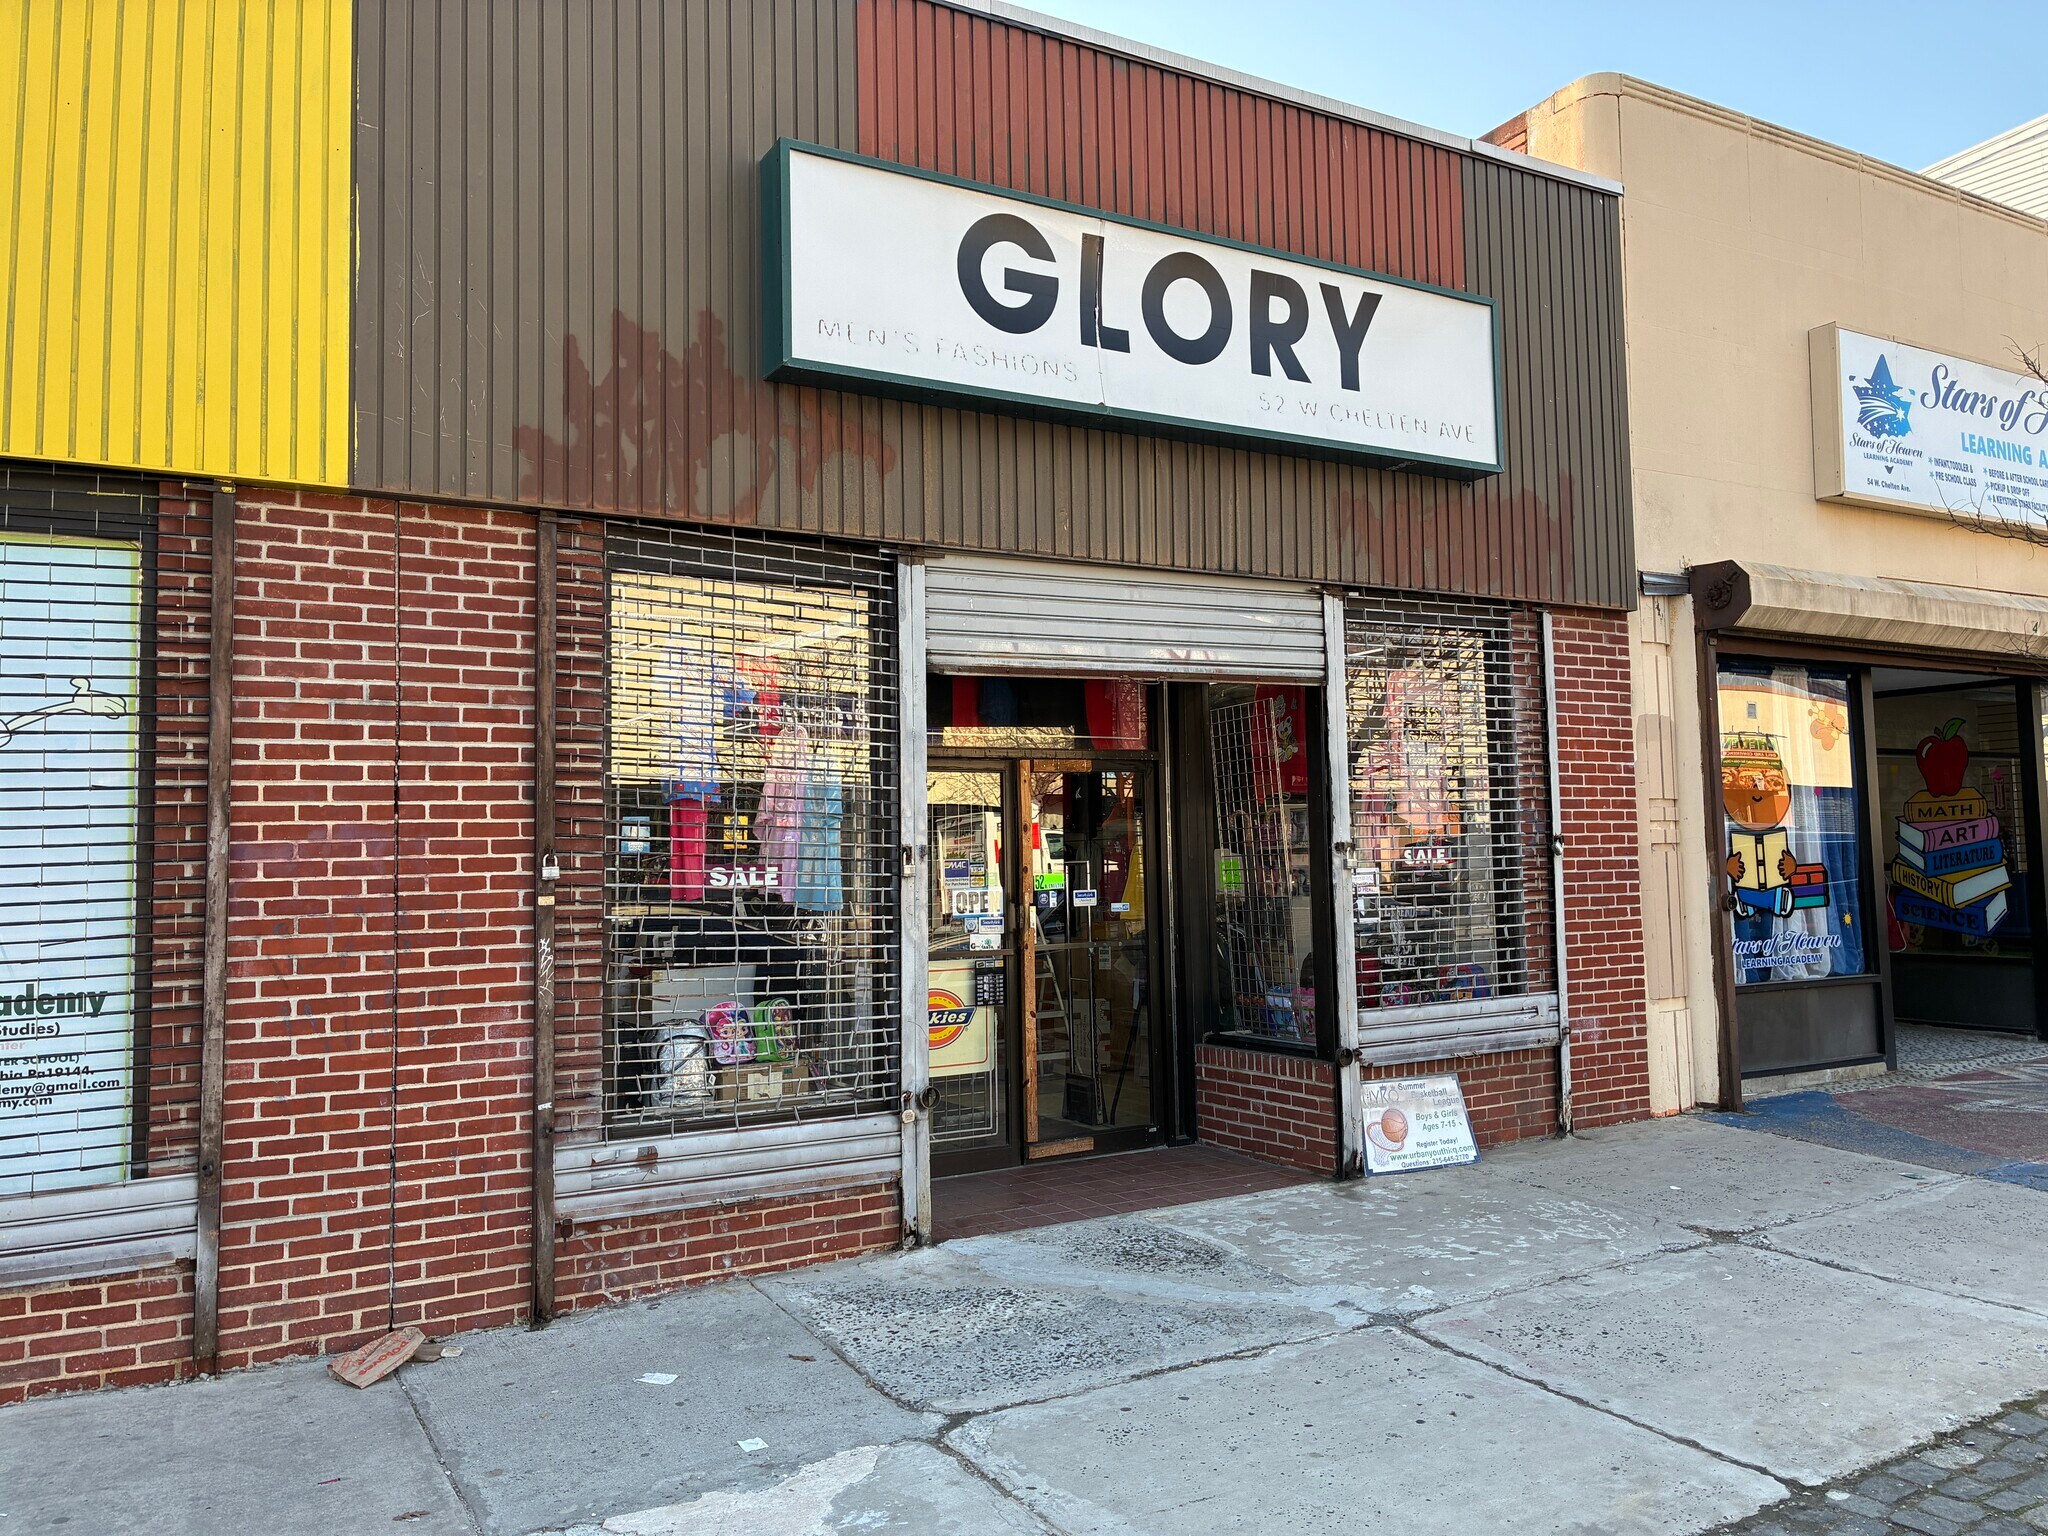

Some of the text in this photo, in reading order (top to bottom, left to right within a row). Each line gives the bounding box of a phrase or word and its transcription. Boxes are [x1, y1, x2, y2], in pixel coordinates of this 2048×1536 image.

[957, 213, 1383, 392] GLORY
[818, 319, 1078, 382] MEN'S FASHIONS
[1920, 362, 1998, 419] Stars
[1999, 390, 2035, 431] of
[1259, 392, 1475, 443] 52 W CHELTEN AVE
[1849, 431, 1923, 459] Stars of Heaven
[1961, 432, 2033, 466] LEARNING
[1863, 452, 1913, 467] LEARNING ACADEMY
[1867, 477, 1875, 486] 54
[1935, 471, 1977, 488] PRE SCHOOL CLASS
[1988, 468, 2005, 481] BEFORE
[2009, 472, 2023, 484] AFTER
[2022, 474, 2040, 487] SCHOOL
[1918, 803, 1973, 818] MATH
[1939, 824, 1979, 846] ART
[949, 861, 967, 870] MAC
[1404, 849, 1448, 865] SALE
[1933, 845, 1995, 871] LITERATURE
[709, 866, 778, 887] SALE
[1035, 875, 1044, 889] 52
[1902, 869, 1941, 897] HISTORY
[955, 891, 1001, 914] OPEN
[1901, 903, 1980, 930] SCIENCE
[1762, 932, 1783, 956] of
[1778, 929, 1842, 954] Heaven
[1742, 953, 1824, 969] LEARNING ACADEMY
[928, 1011, 967, 1025] kies
[22, 1054, 80, 1065] SCHOOL)
[0, 1079, 120, 1097] emy@gmail.com
[1397, 1082, 1426, 1091] Summer
[1415, 1112, 1432, 1121] Boys
[1441, 1108, 1458, 1117] Girls
[1422, 1119, 1457, 1132] Ages 7-15
[1415, 1137, 1459, 1149] Register Today!
[1401, 1160, 1431, 1169] Questions:
